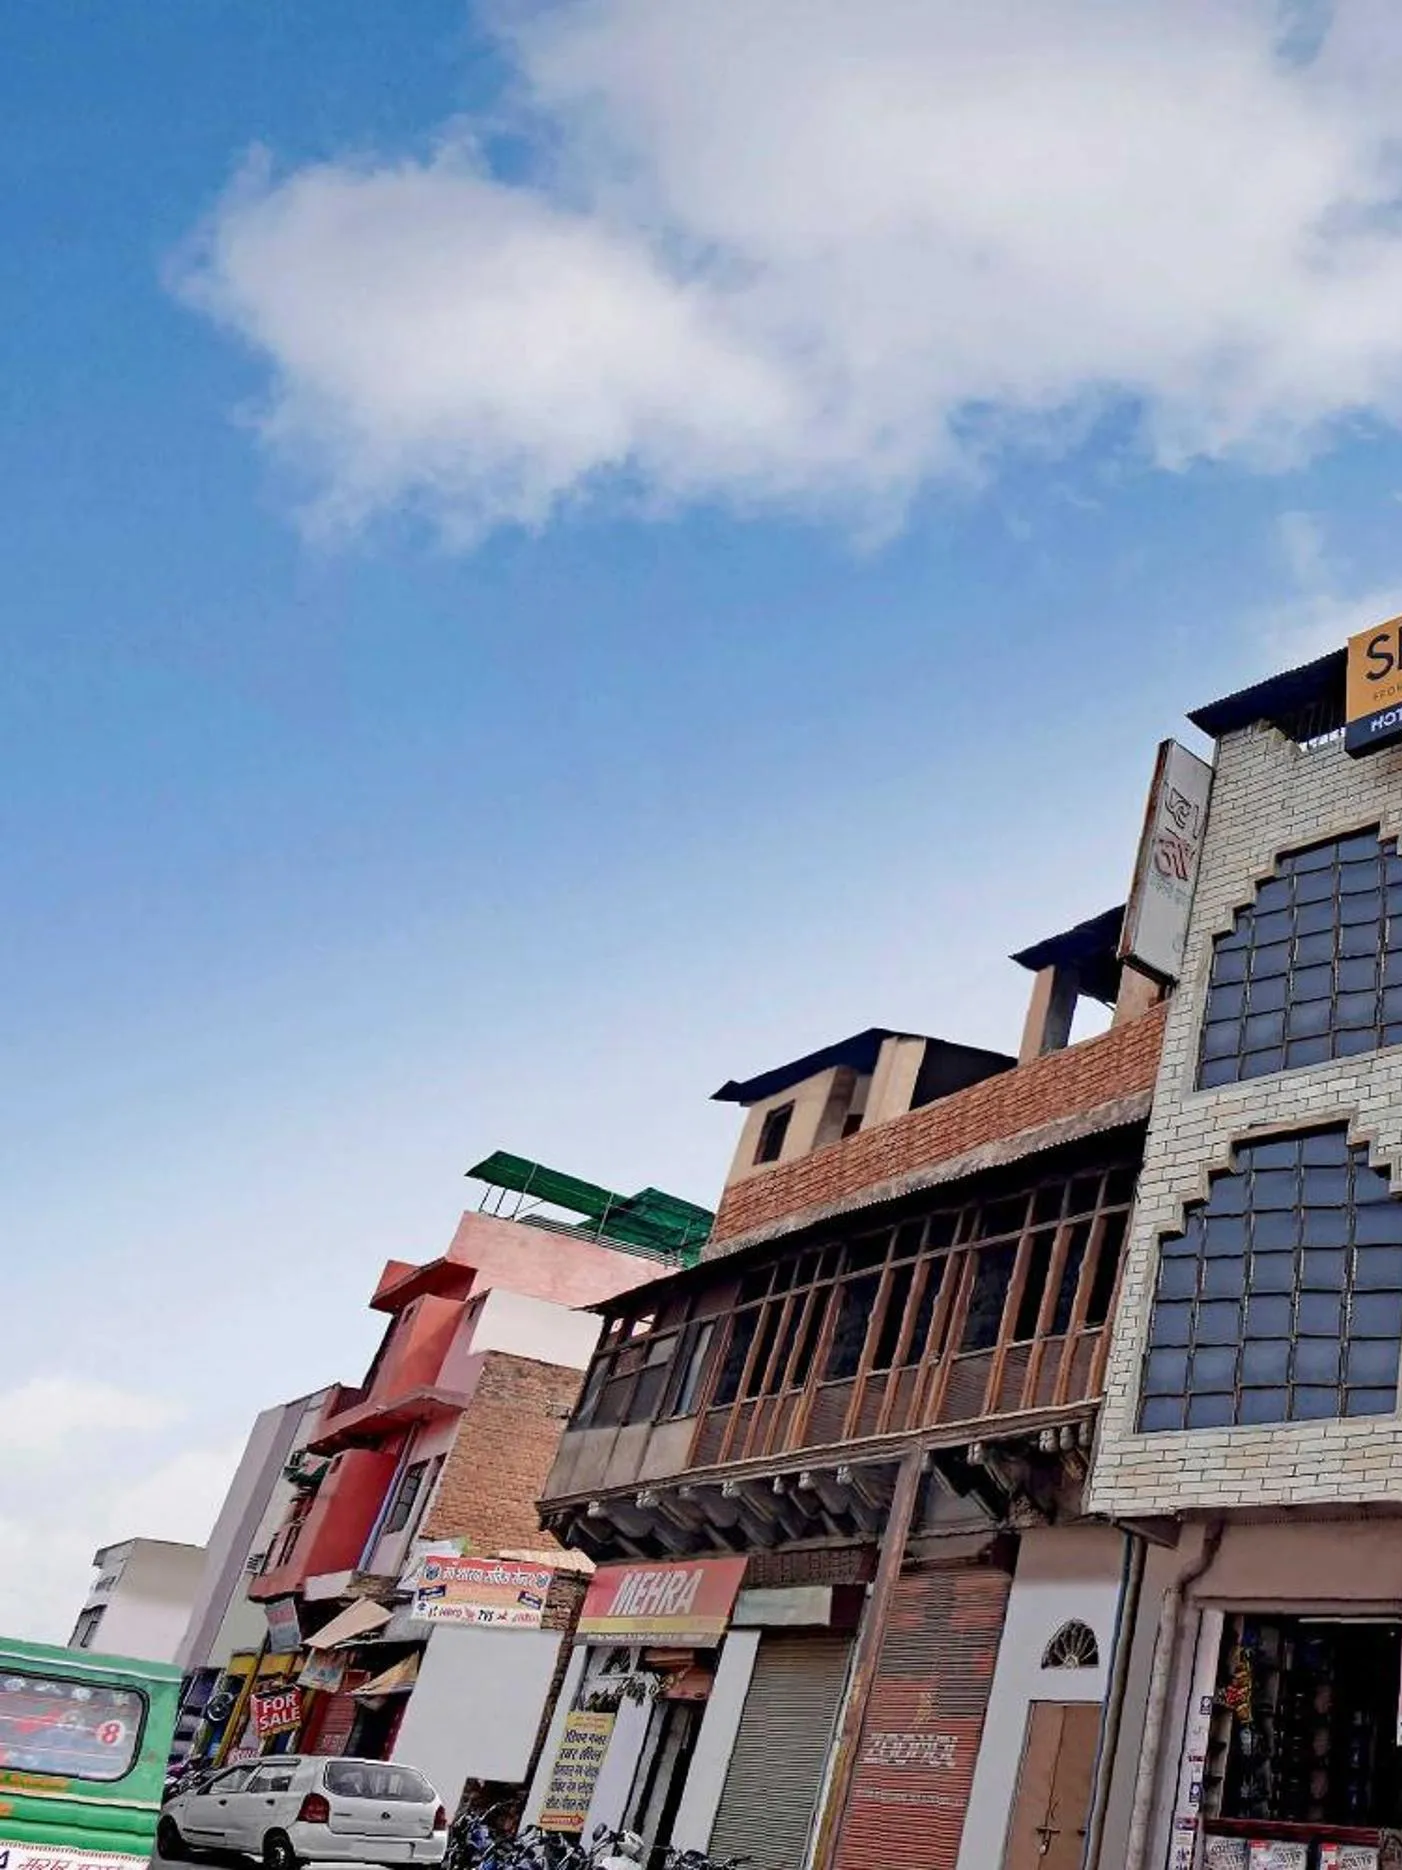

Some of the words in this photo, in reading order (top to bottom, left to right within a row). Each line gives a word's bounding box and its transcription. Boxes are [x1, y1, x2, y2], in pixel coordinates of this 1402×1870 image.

[608, 1568, 704, 1617] MEHRA
[263, 1693, 297, 1714] FOR
[259, 1706, 300, 1731] SALE
[101, 1723, 120, 1744] 8
